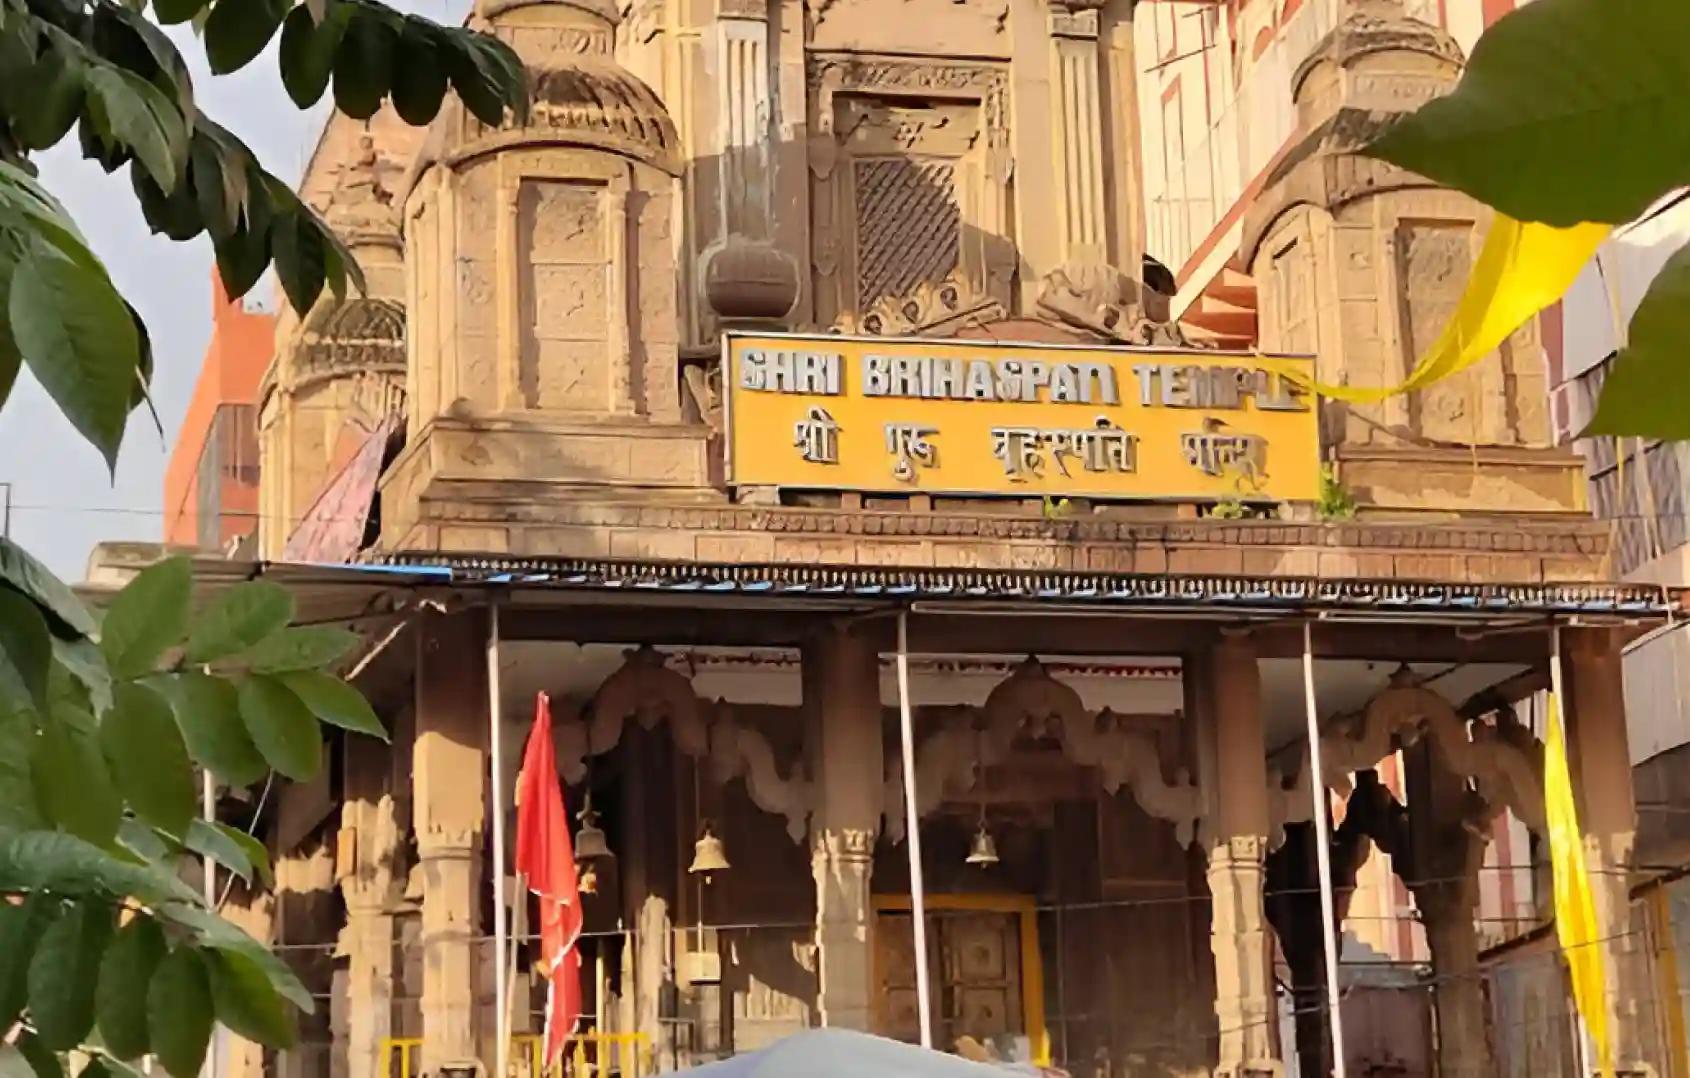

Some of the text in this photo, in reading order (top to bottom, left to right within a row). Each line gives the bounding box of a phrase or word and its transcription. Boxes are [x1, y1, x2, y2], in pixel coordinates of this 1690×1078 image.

[740, 350, 840, 394] SHRI
[862, 355, 1117, 403] BRIHASPATI
[794, 405, 838, 463] श्री
